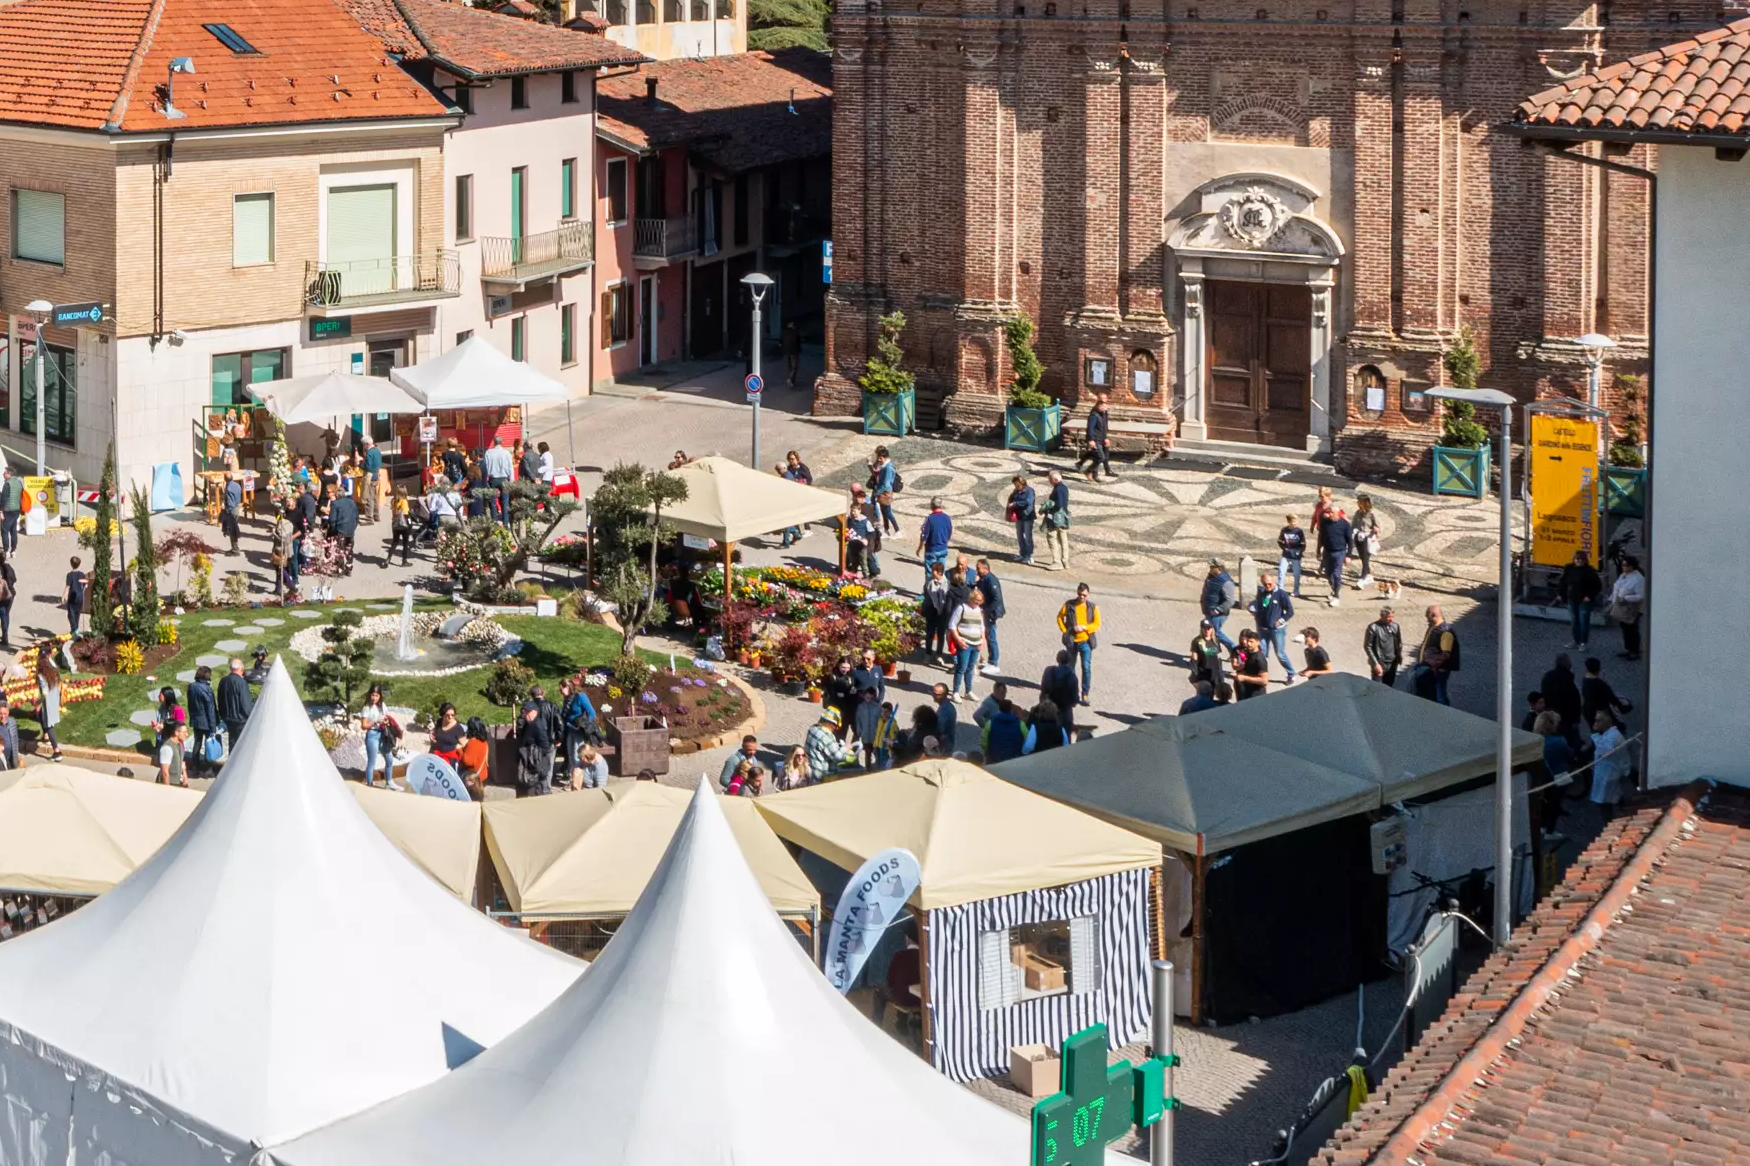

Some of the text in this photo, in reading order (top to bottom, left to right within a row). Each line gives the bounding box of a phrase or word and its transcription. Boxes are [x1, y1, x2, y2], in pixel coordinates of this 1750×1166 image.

[58, 310, 90, 321] BANCOMAT
[834, 857, 900, 990] LA MANTA FOODS
